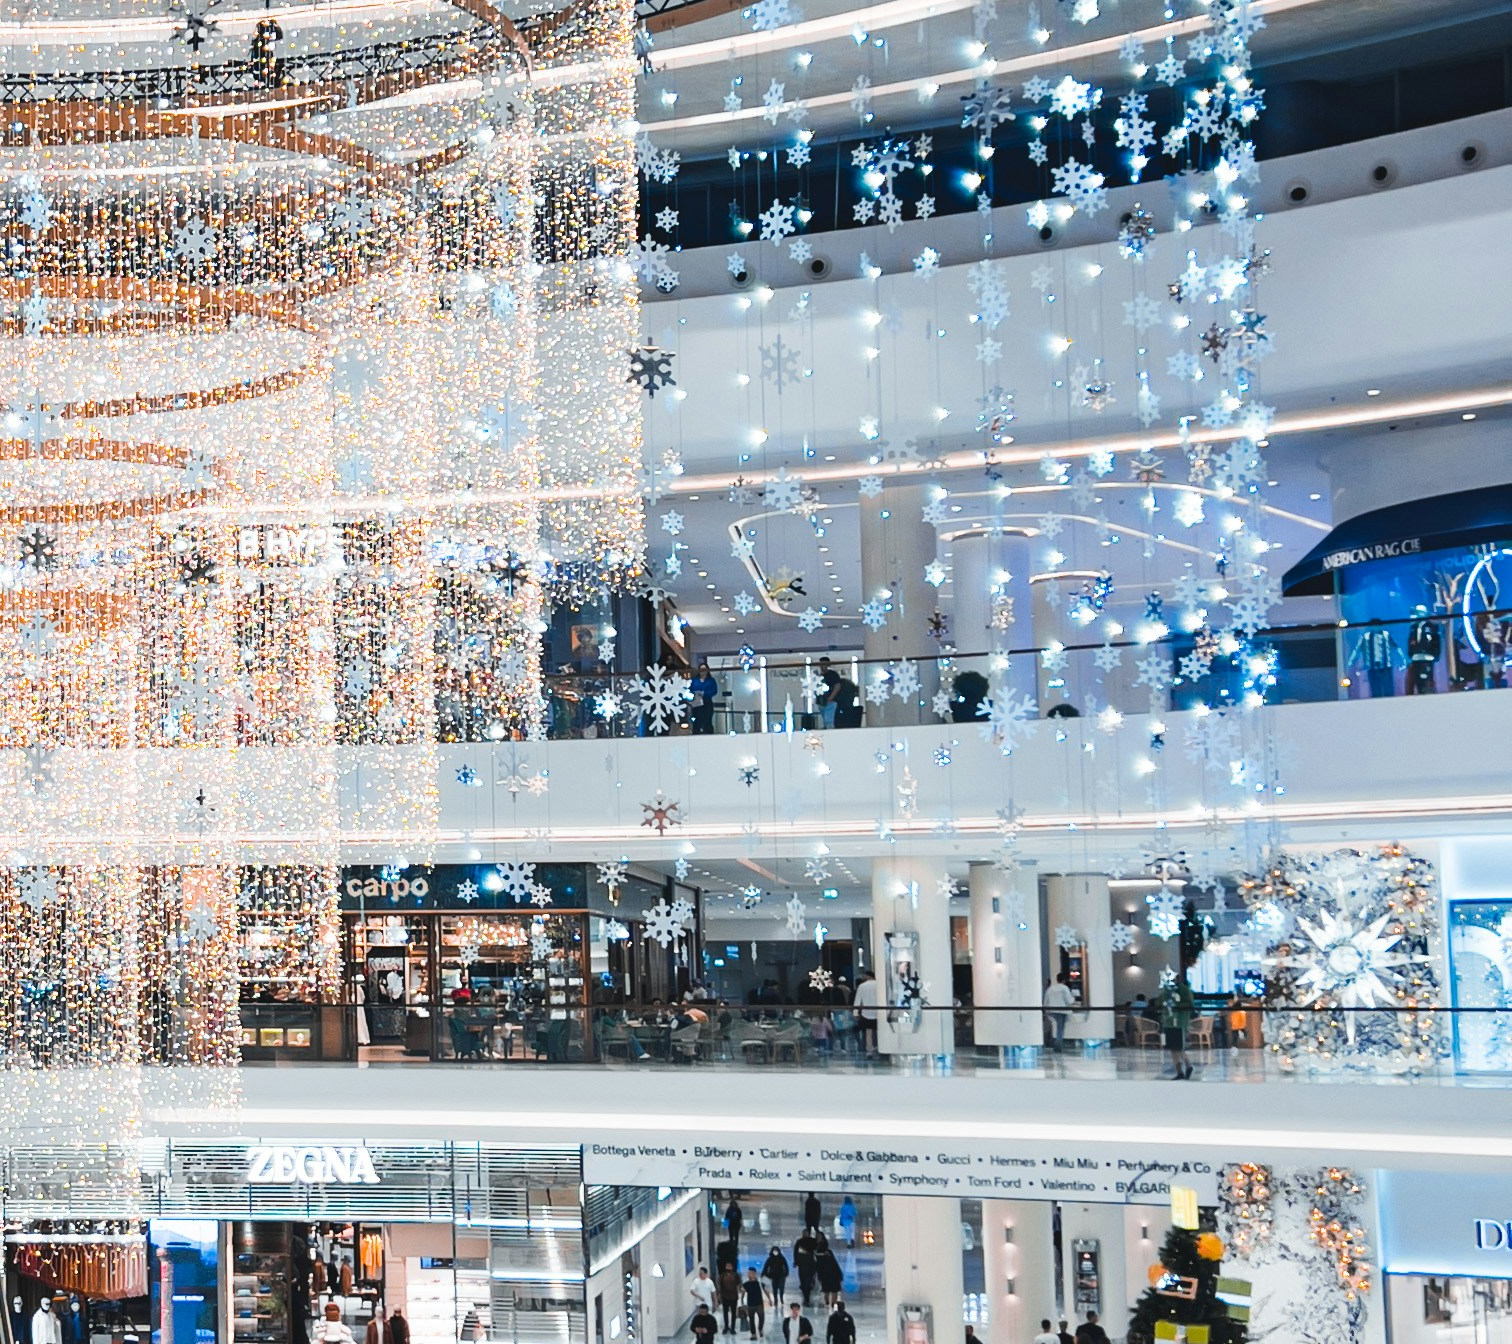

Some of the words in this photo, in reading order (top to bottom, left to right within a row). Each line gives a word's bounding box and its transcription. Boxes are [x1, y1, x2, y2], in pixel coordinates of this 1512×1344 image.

[1322, 546, 1374, 570] AMERICAN
[1375, 542, 1399, 557] RAG
[346, 878, 429, 902] carpo
[247, 1146, 381, 1184] ZEGNA
[592, 1145, 636, 1157] Bottega
[638, 1145, 676, 1157] Veneta
[694, 1146, 742, 1161] Burberry
[760, 1148, 799, 1160] Cartier
[820, 1149, 854, 1161] Dolce
[855, 1150, 864, 1161] &
[866, 1150, 919, 1164] Gabbana
[937, 1153, 971, 1165] Gucci
[990, 1155, 1036, 1168] Hermes
[1053, 1157, 1075, 1169] Miu
[1077, 1158, 1099, 1170] Miu
[1117, 1159, 1179, 1175] Perfumery
[1182, 1162, 1190, 1173] &
[1193, 1162, 1211, 1174] Co
[699, 1167, 732, 1179] Prada
[749, 1168, 780, 1180] Rolex
[798, 1170, 826, 1181] Saint
[829, 1171, 872, 1183] Laurent
[889, 1173, 949, 1188] Symphony
[968, 1175, 992, 1187] Tom
[994, 1176, 1021, 1188] Ford
[1040, 1177, 1096, 1192] Valentino
